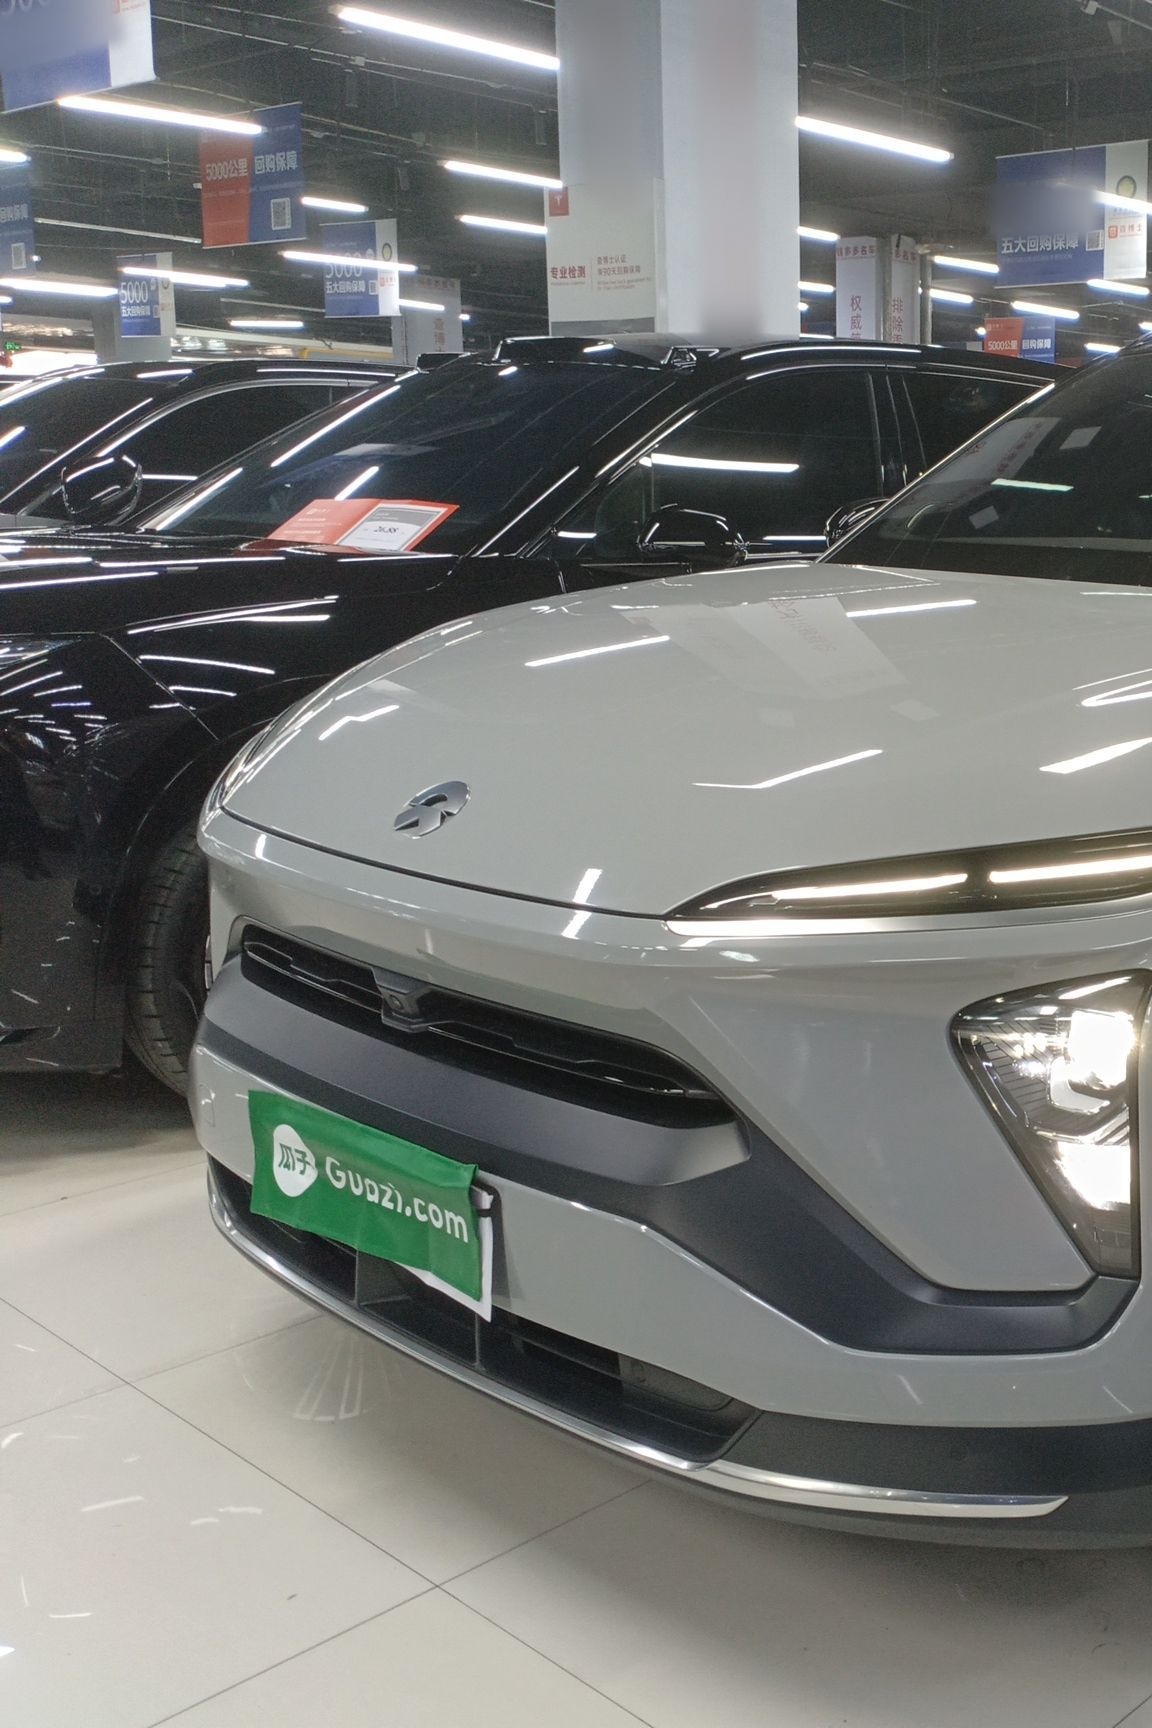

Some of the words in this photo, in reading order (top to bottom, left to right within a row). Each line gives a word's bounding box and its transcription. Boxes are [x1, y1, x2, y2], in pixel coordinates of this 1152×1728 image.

[206, 158, 248, 181] 5000公里
[254, 150, 298, 175] 回购保障
[1001, 233, 1078, 254] 五大回购保障
[550, 265, 587, 280] 专业检测
[120, 281, 149, 305] 5000
[325, 280, 366, 295] 五大回购保障
[988, 340, 1018, 351] 5000公里
[278, 1142, 315, 1177] 瓜子
[324, 1156, 469, 1244] Guazi.com
